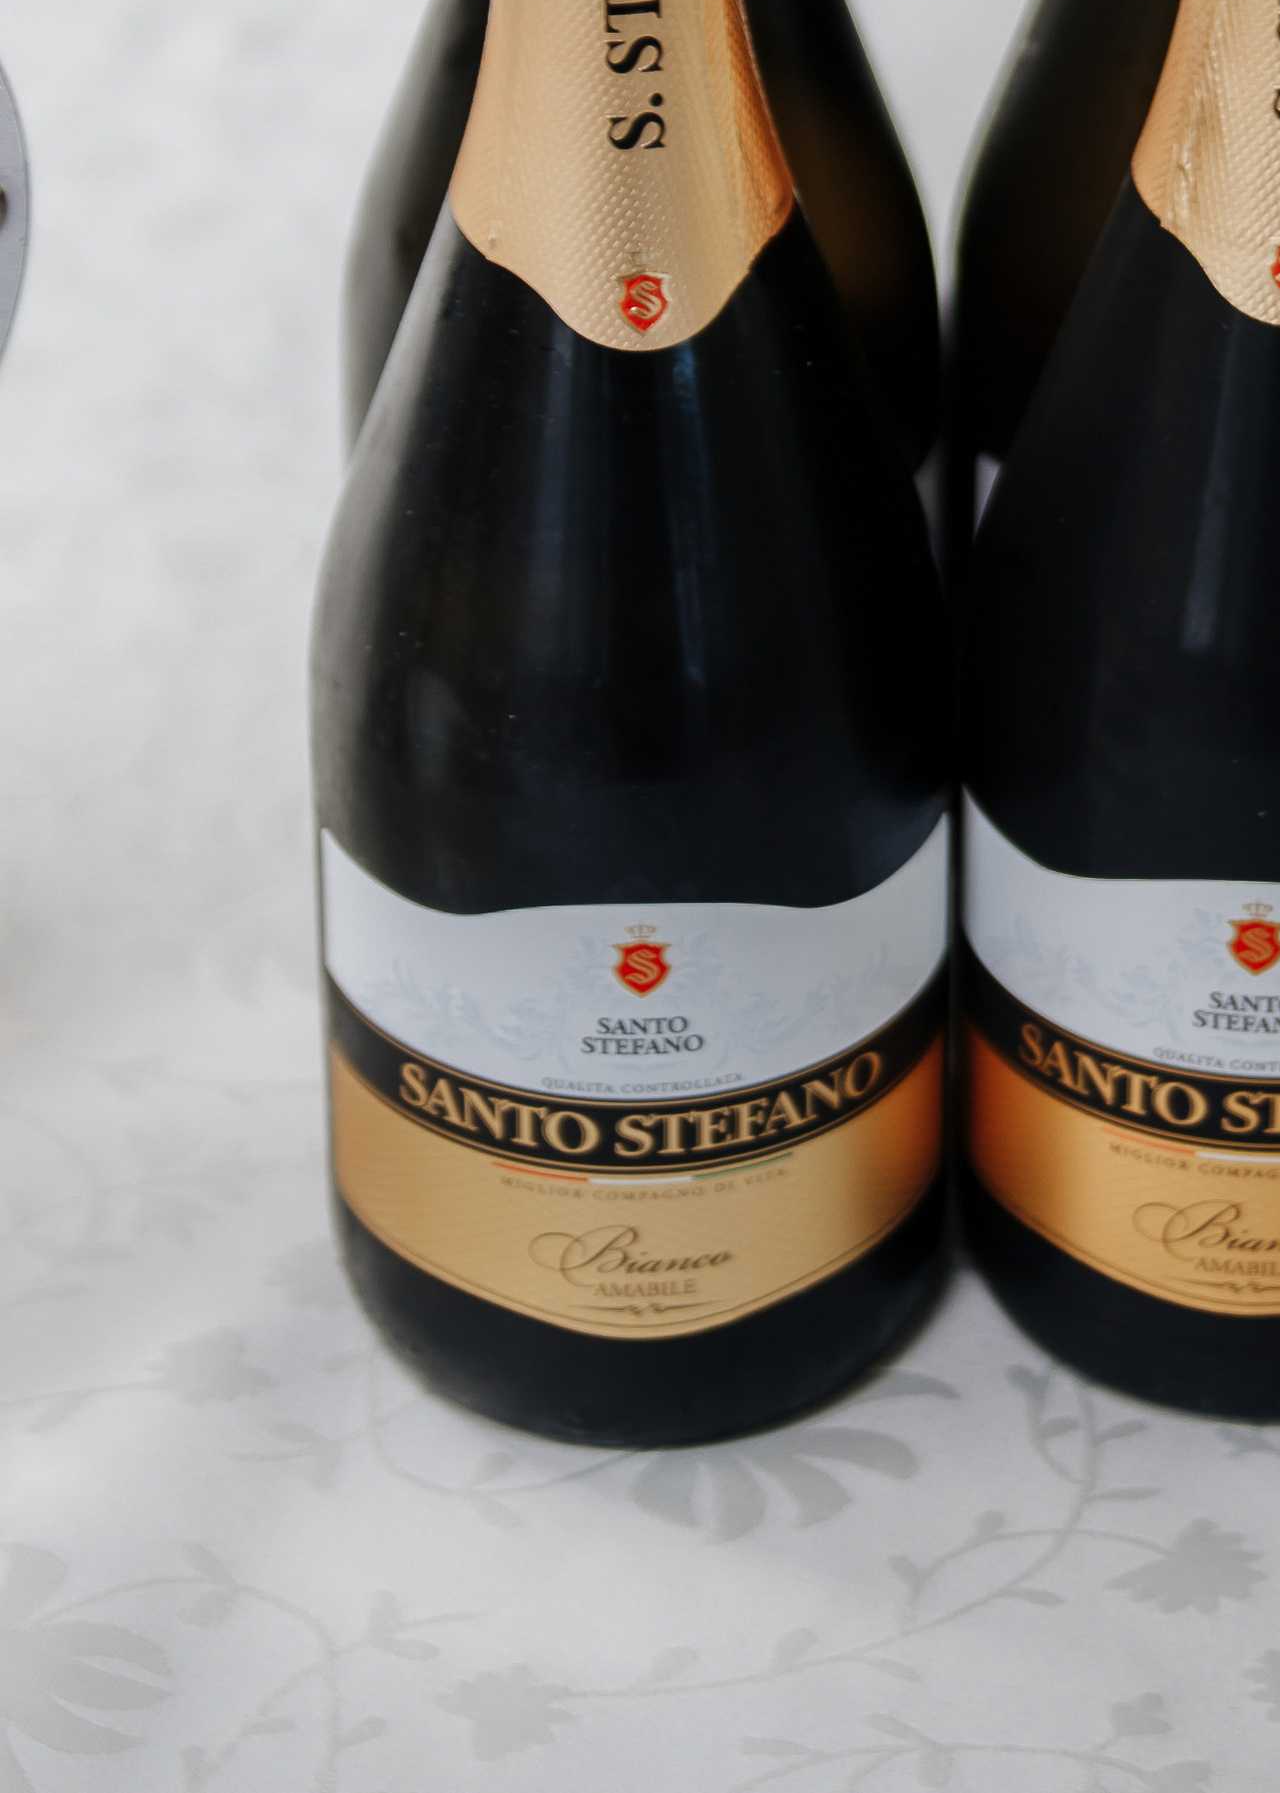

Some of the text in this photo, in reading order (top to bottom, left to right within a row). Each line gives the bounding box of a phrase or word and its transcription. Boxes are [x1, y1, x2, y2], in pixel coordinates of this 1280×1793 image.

[605, 92, 666, 151] S.
[580, 1035, 706, 1055] STEFANO
[596, 1015, 690, 1036] SANTO
[400, 1051, 883, 1157] SANTO STEFANO
[1017, 1022, 1206, 1128] SANTO
[527, 1224, 734, 1288] Bianco
[593, 1278, 698, 1299] AMABILE
